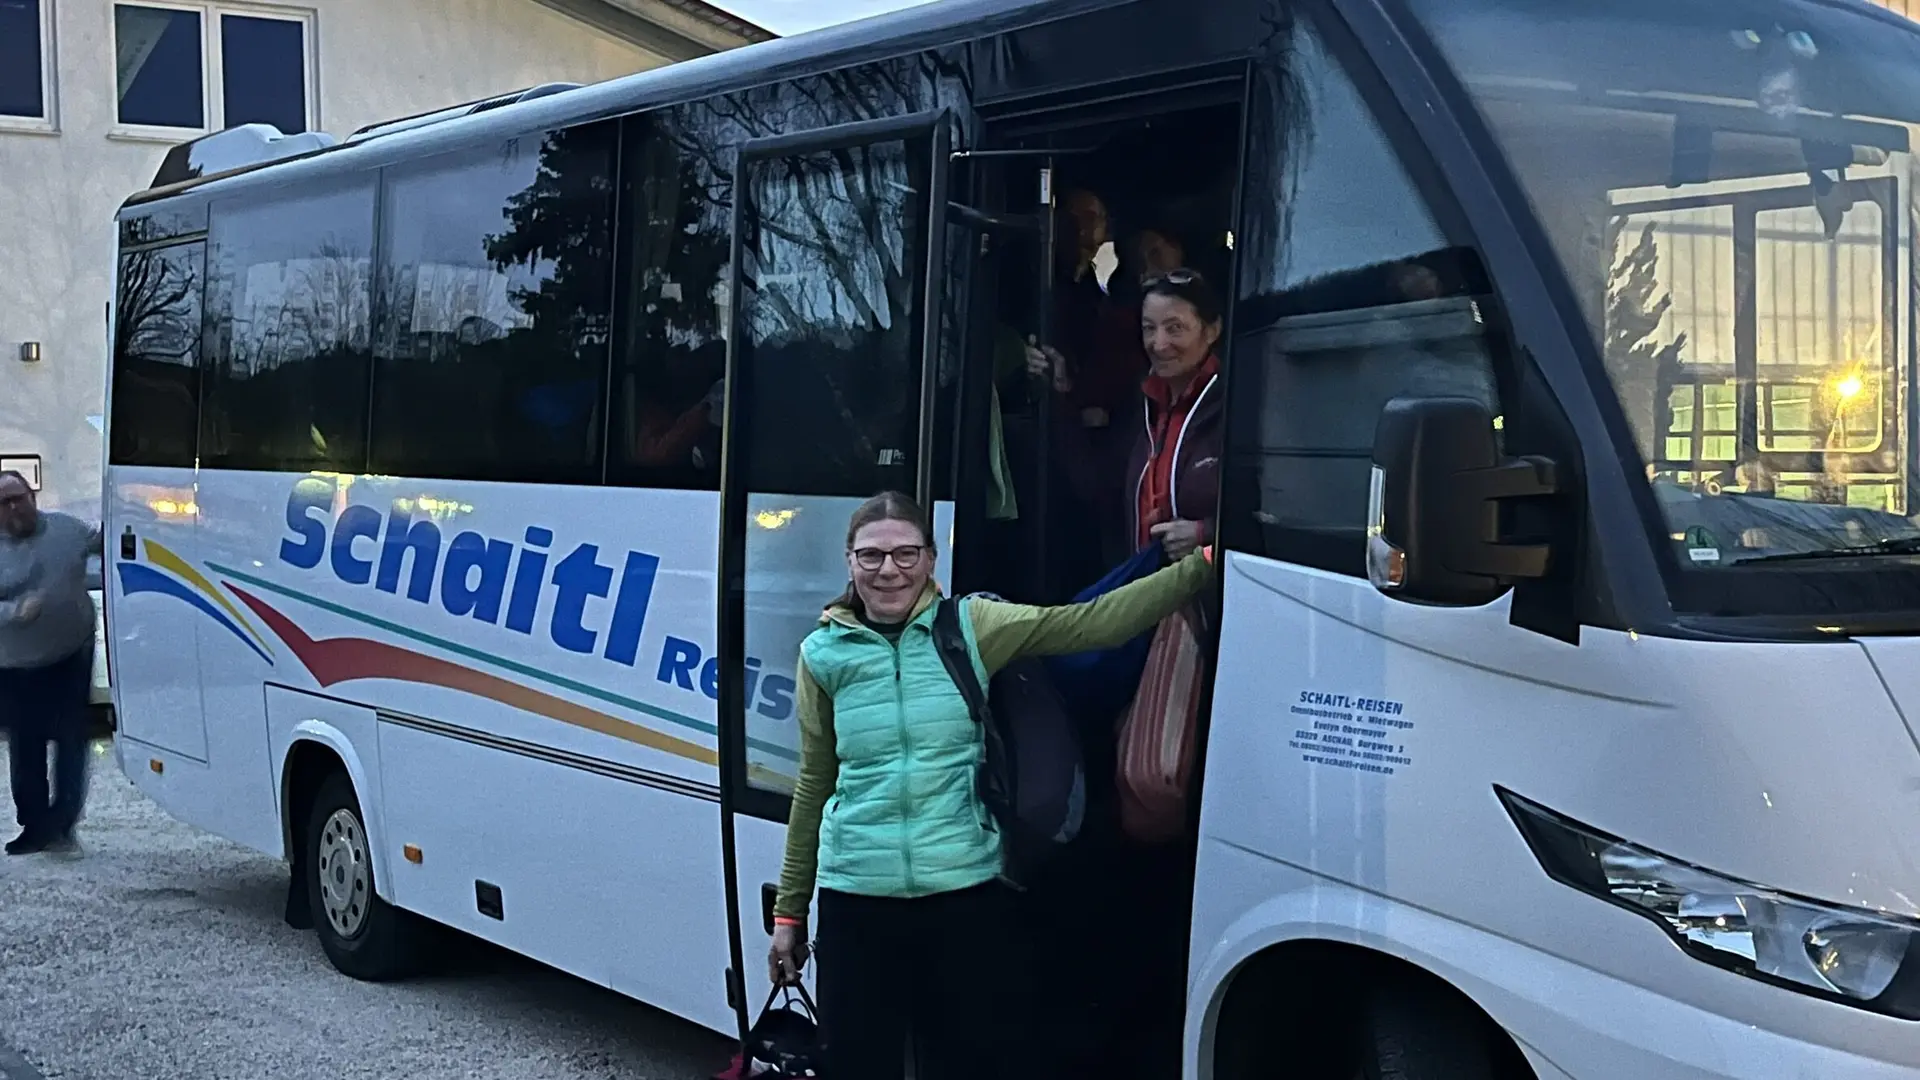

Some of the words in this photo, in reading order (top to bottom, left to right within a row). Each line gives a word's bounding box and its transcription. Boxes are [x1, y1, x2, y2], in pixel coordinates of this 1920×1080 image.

[279, 478, 660, 667] Schaitl
[1300, 691, 1403, 715] SCHAITL-REISEN
[1290, 705, 1353, 721] Omnibusbetrieb
[1368, 715, 1414, 729] Mietwagen
[1313, 721, 1340, 732] Evelyn
[1358, 740, 1394, 753] Burgweg
[1303, 755, 1394, 775] www.schaitl-reisen.de
